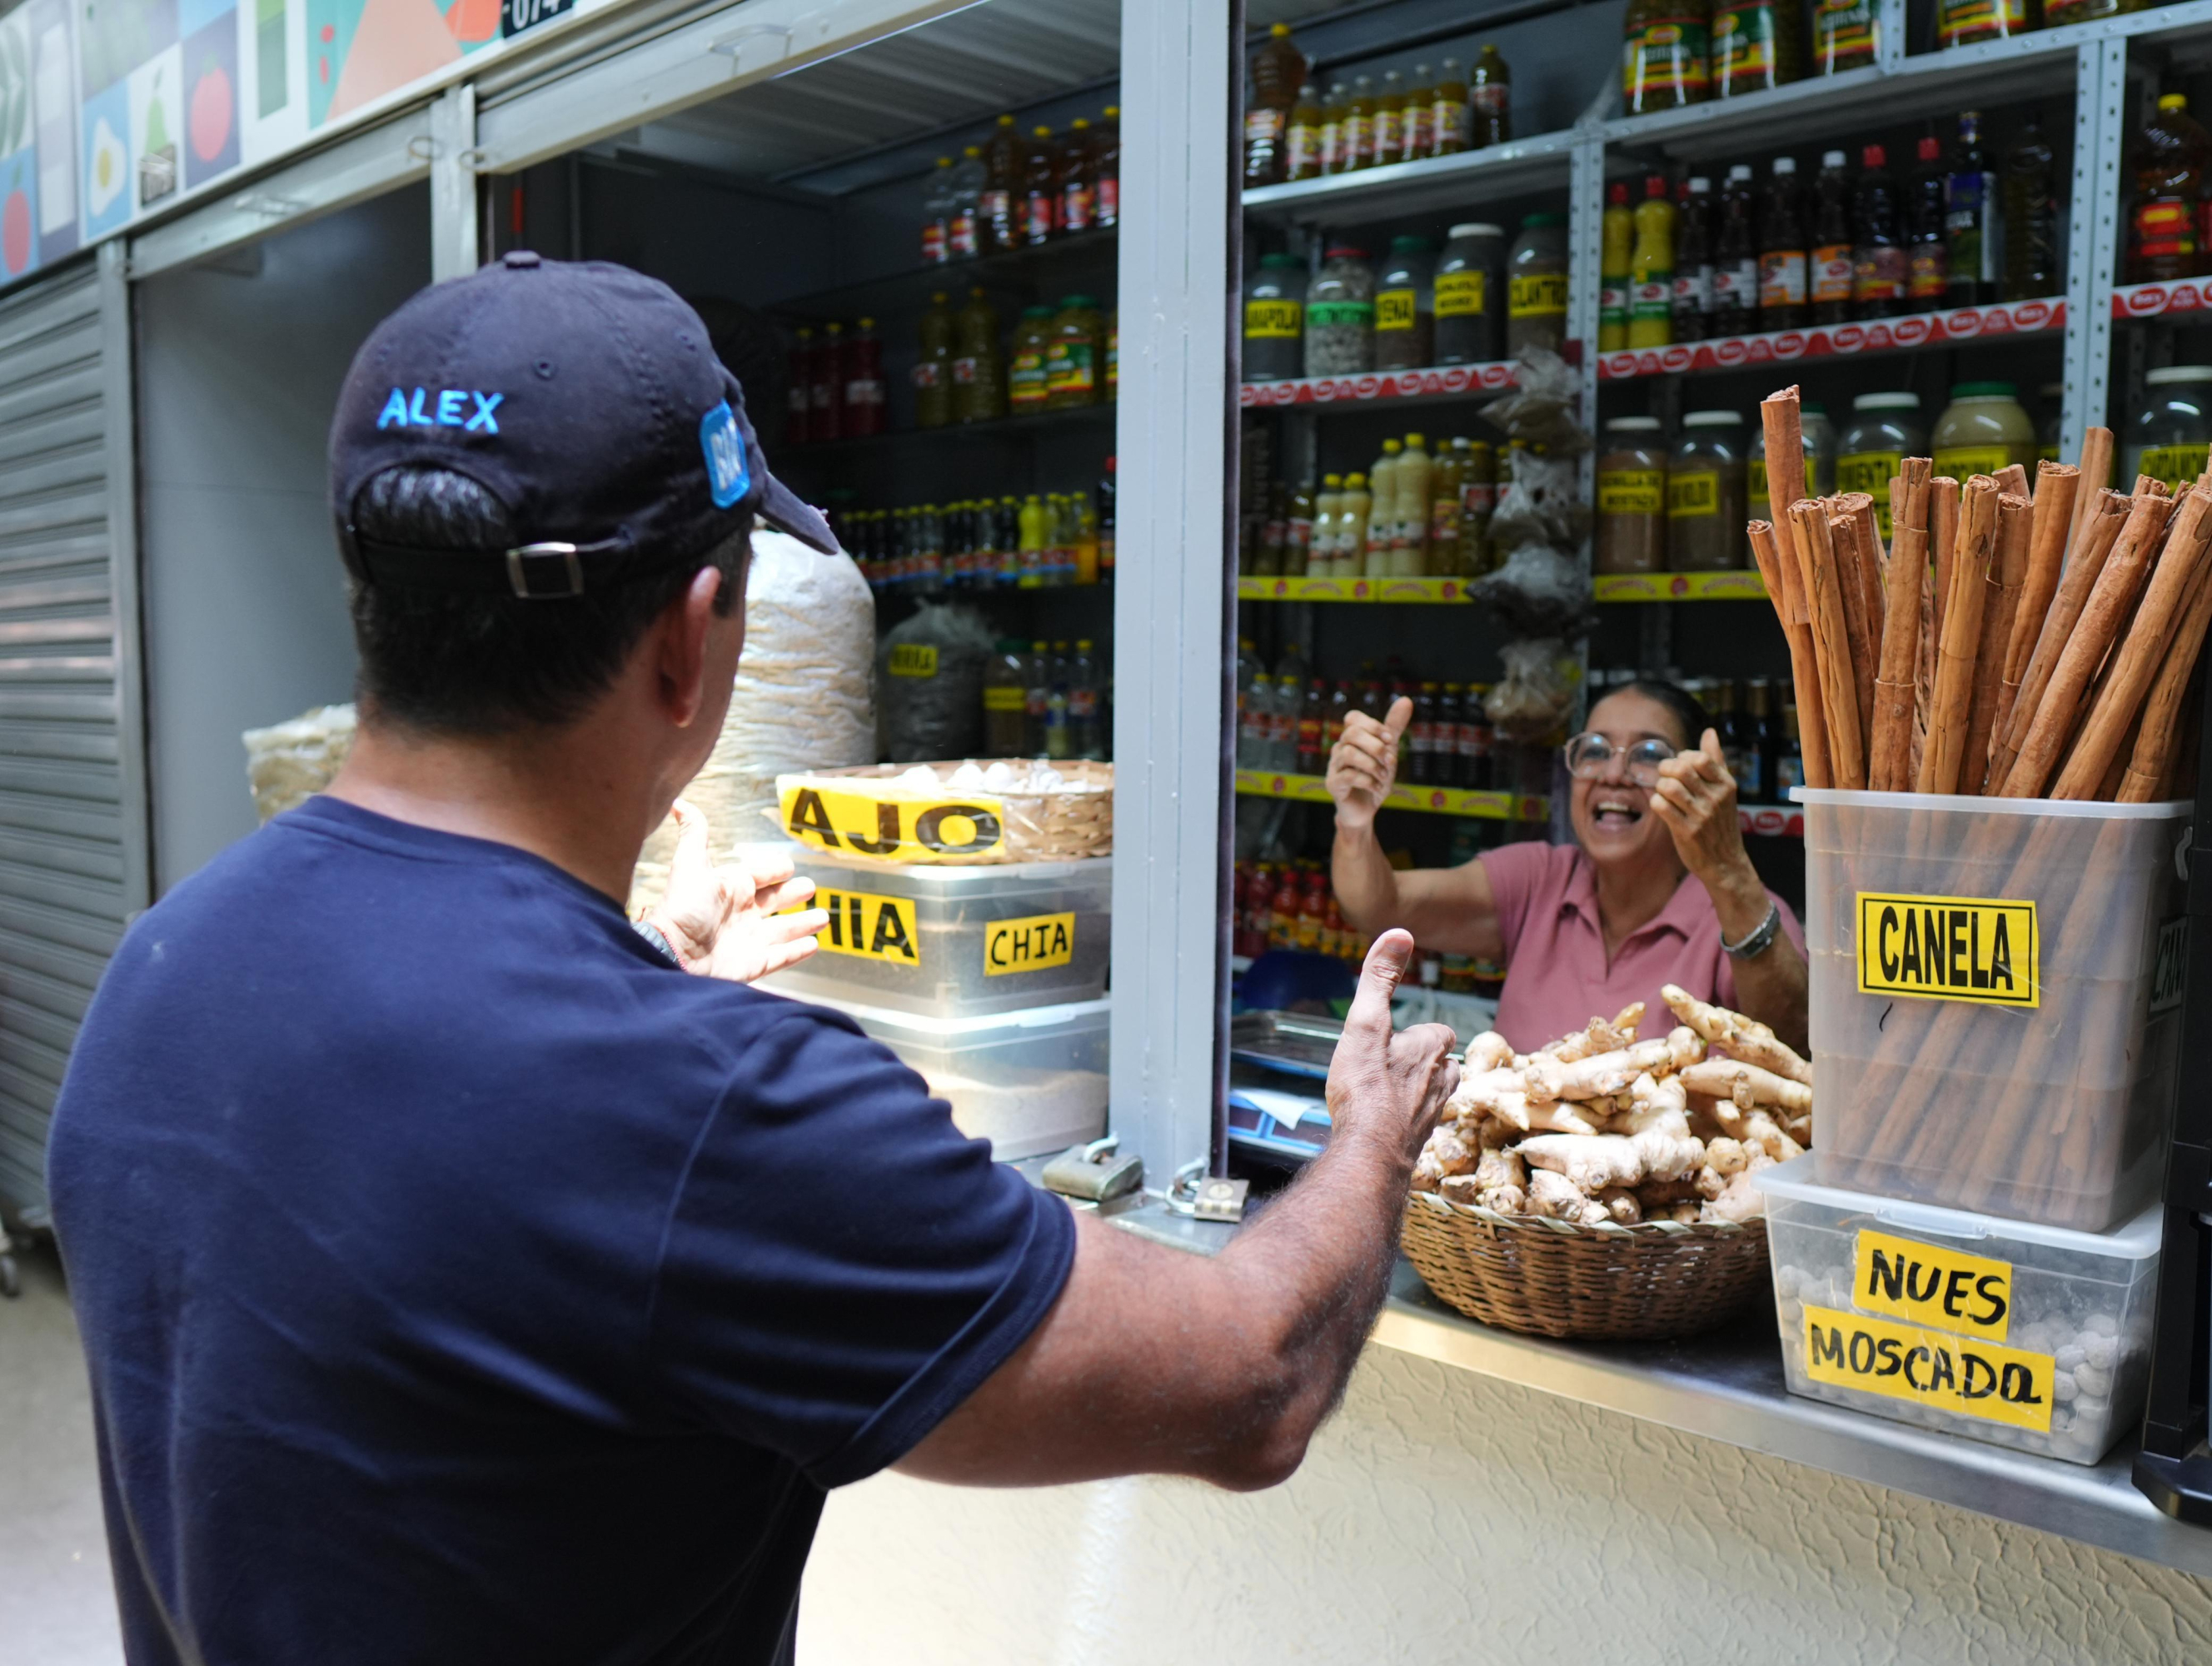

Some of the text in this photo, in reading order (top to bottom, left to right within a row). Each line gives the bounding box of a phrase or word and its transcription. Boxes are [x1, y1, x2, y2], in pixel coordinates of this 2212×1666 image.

[377, 387, 504, 434] ALEX
[789, 787, 1001, 855] AJO
[771, 892, 916, 959] HIA
[989, 922, 1069, 966] CHIA
[1878, 905, 2014, 991] CANELA
[1868, 1249, 2008, 1326] NUES
